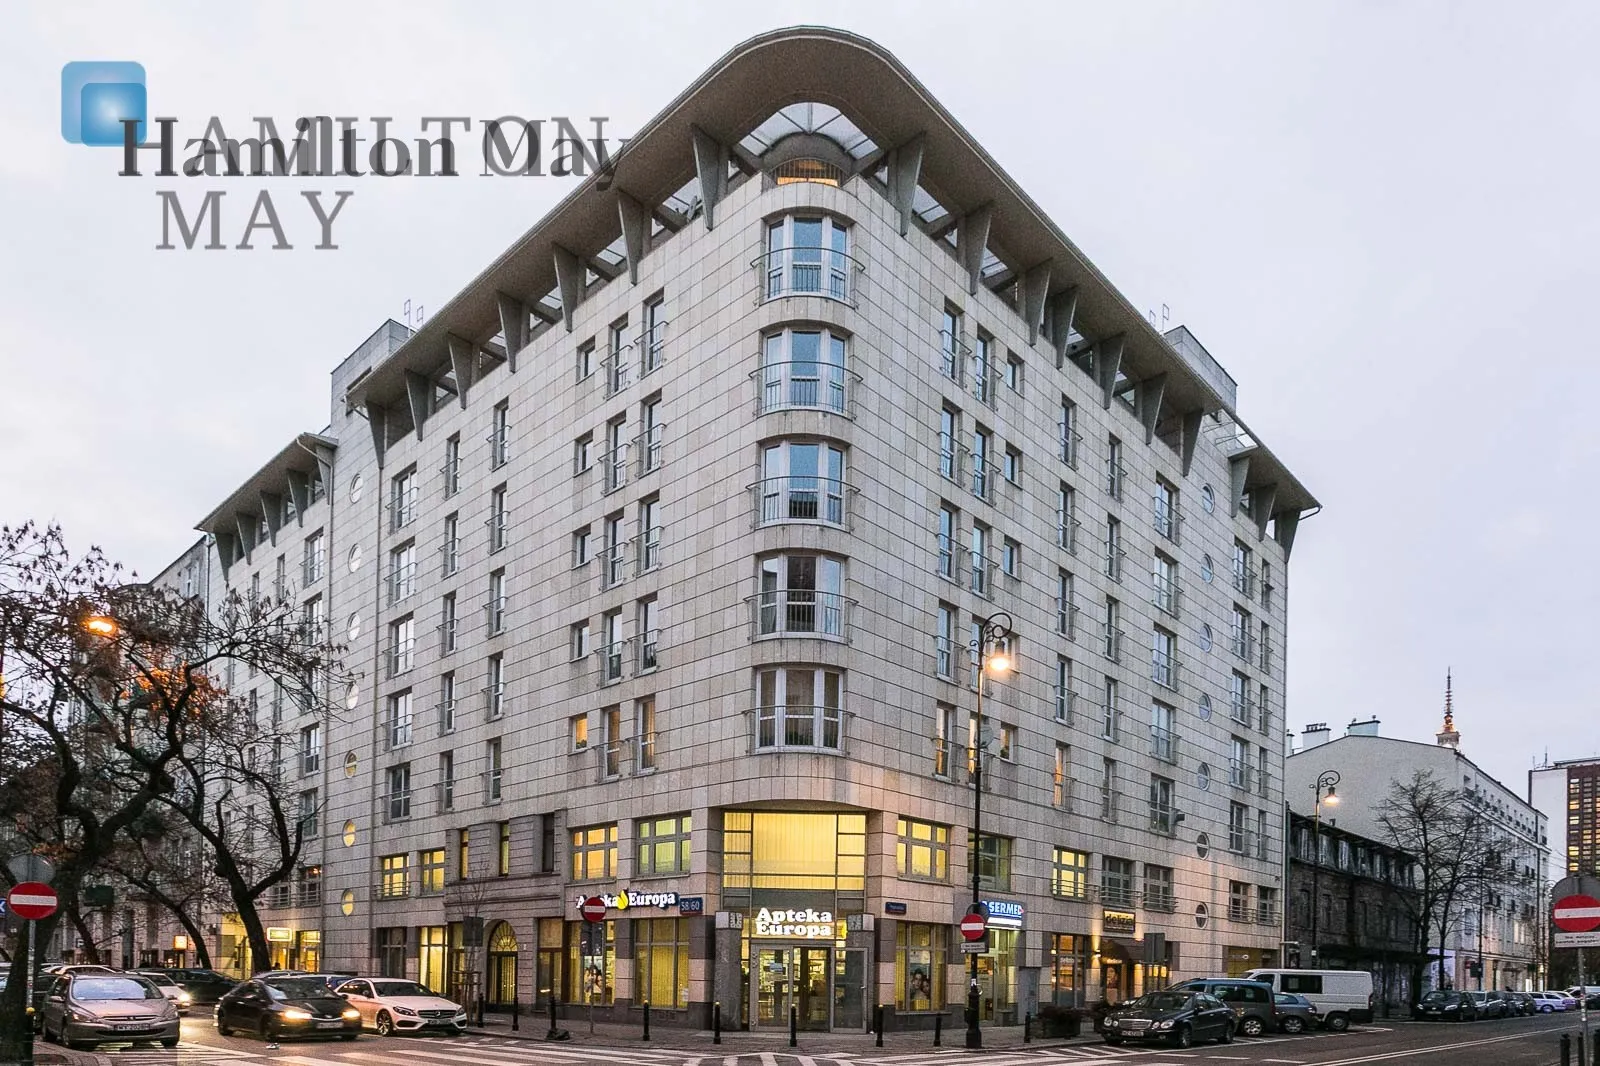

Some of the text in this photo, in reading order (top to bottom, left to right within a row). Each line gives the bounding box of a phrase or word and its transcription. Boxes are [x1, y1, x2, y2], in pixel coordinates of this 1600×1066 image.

[627, 892, 676, 907] Europa
[755, 907, 832, 924] Apteka
[755, 921, 832, 939] Europa
